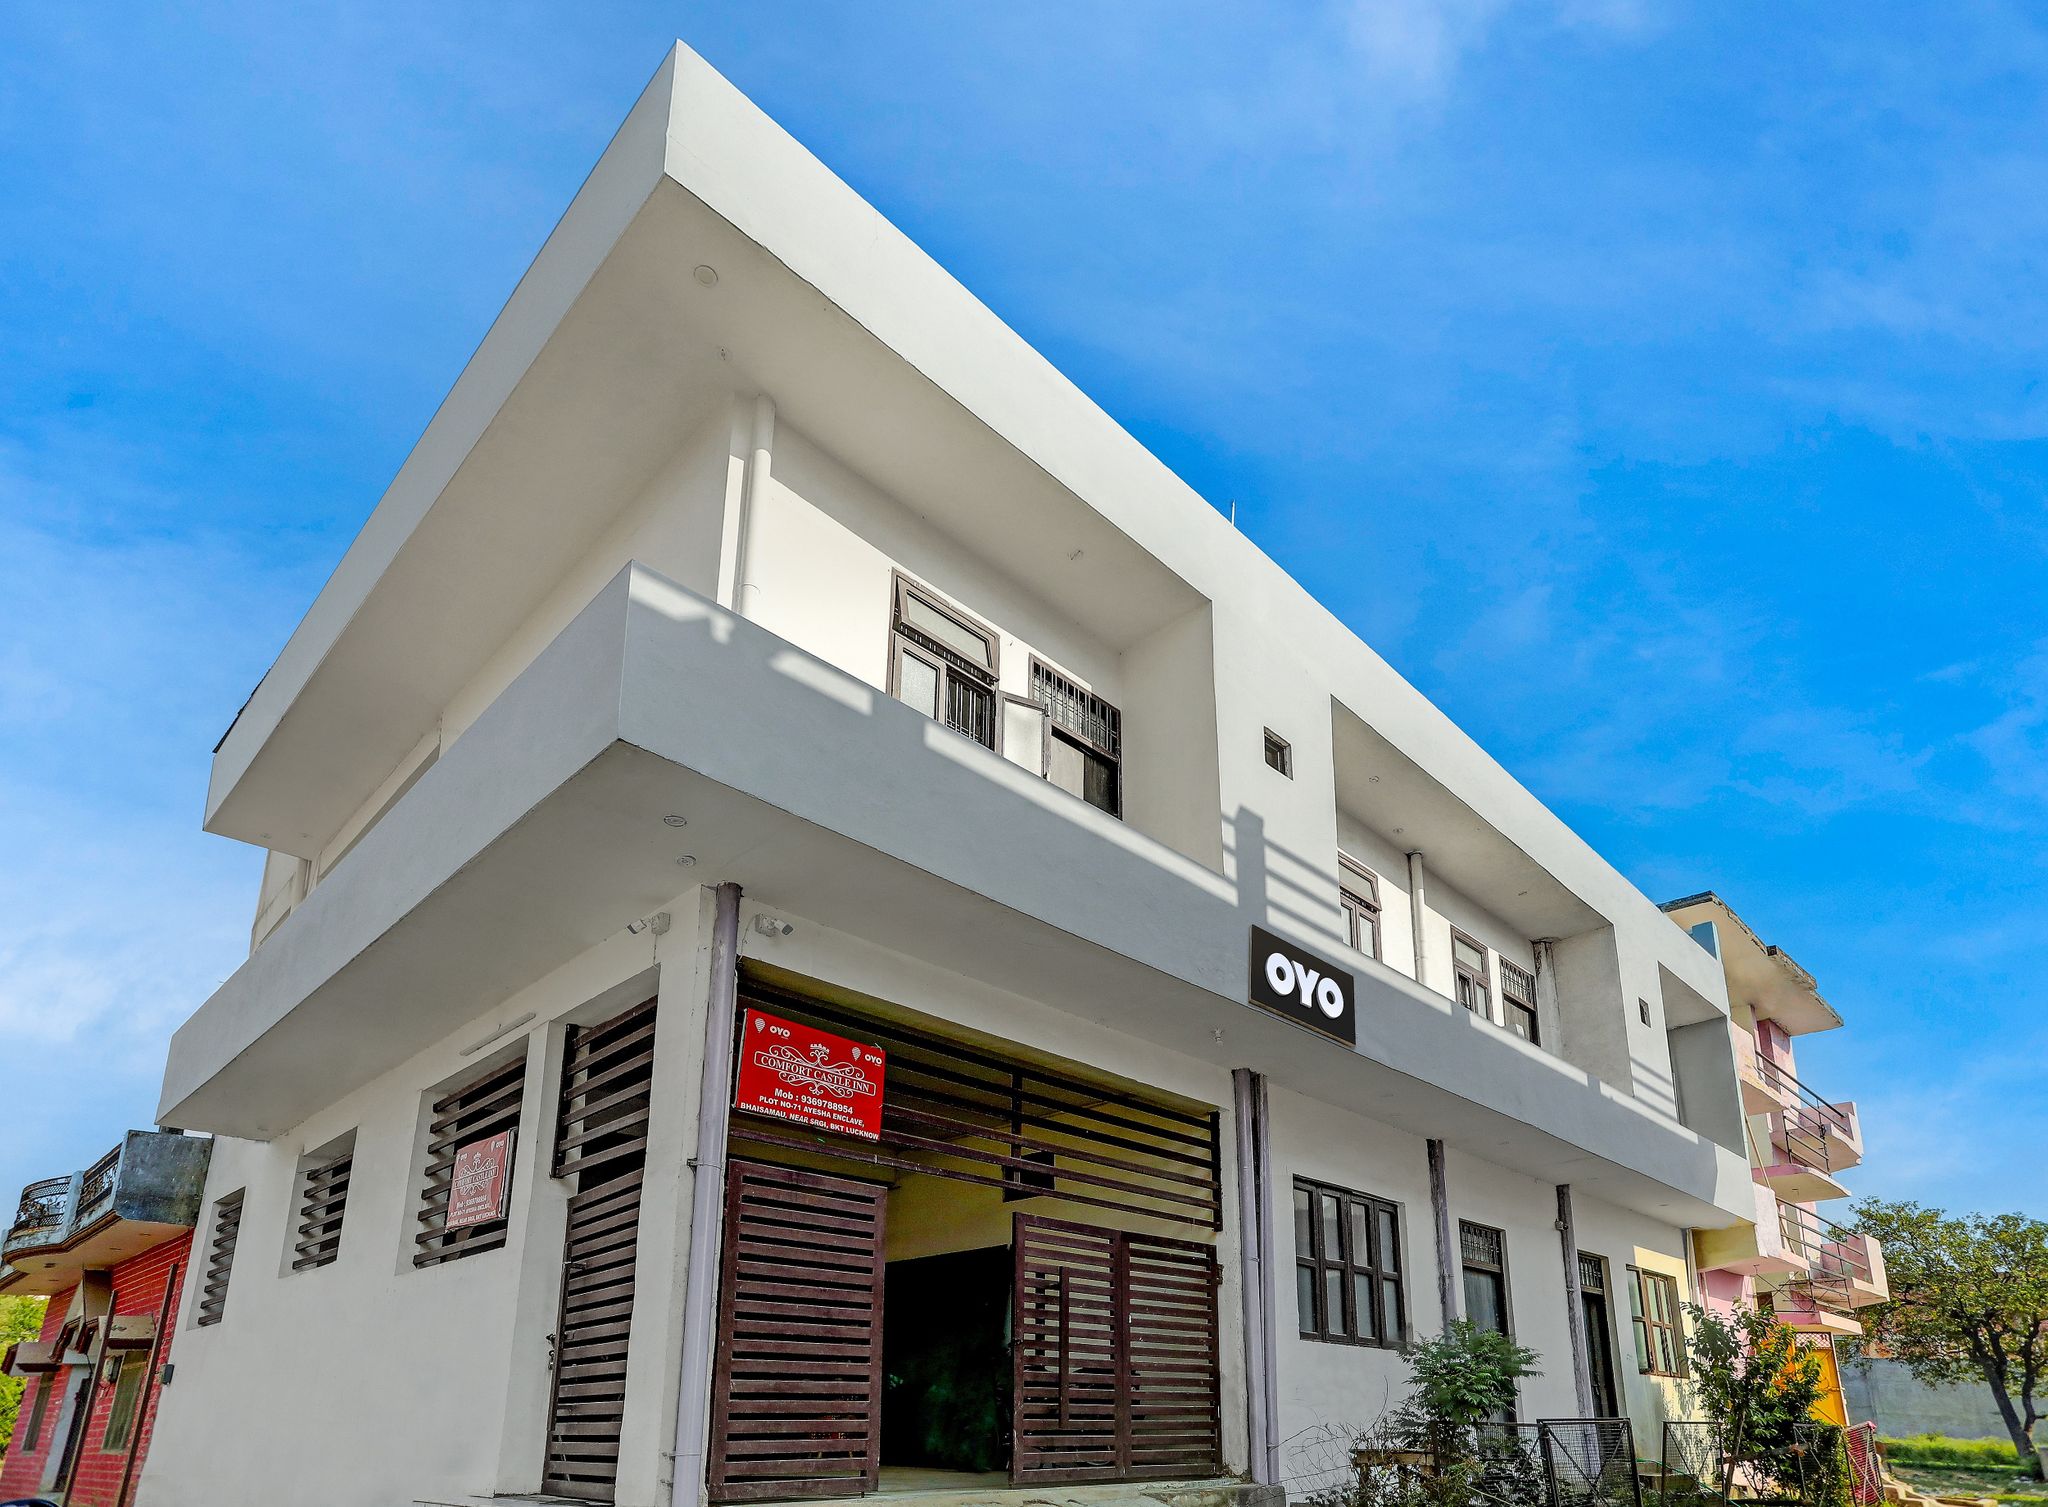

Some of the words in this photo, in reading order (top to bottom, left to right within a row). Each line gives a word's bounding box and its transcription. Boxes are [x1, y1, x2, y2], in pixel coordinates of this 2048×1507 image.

[1265, 953, 1344, 1019] OYO
[769, 1025, 791, 1037] OYO
[864, 1054, 882, 1065] OYO
[761, 1055, 811, 1076] COMFORT
[813, 1070, 851, 1088] CASTLE
[853, 1082, 869, 1093] INN
[759, 1095, 778, 1106] PLOT
[780, 1101, 802, 1111] NO-71
[803, 1106, 831, 1119] AYESHA
[833, 1112, 865, 1128] ENCLAVE,
[774, 1088, 794, 1100] Mob
[801, 1094, 853, 1114] 9369788954
[789, 1114, 809, 1124] NEAR
[830, 1123, 844, 1132] BKT
[845, 1126, 879, 1140] LUCKNOW
